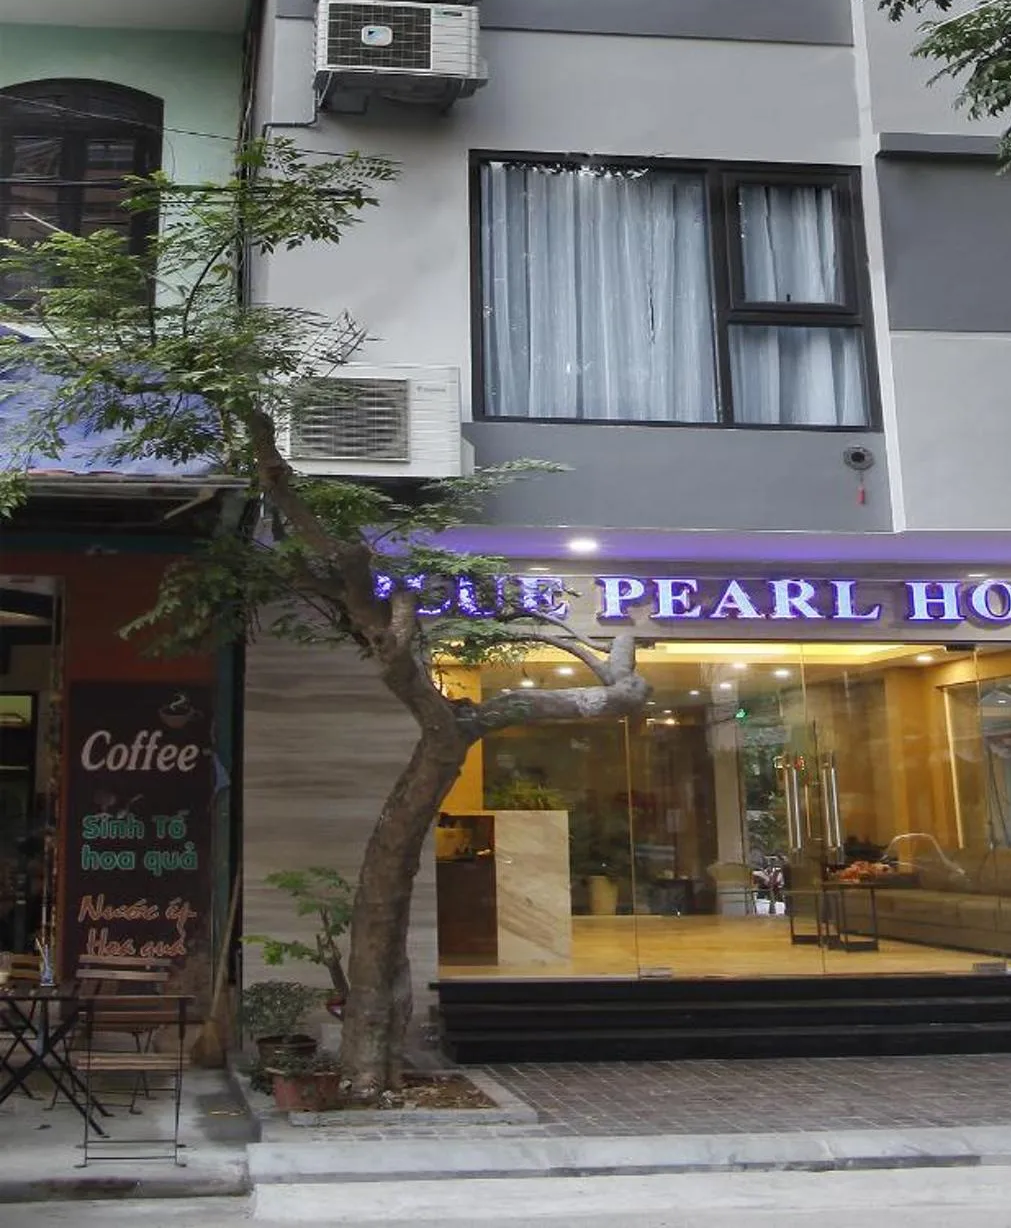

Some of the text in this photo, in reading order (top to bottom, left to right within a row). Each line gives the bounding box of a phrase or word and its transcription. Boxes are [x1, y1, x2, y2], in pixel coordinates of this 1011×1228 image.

[596, 576, 881, 620] PEARL
[81, 730, 200, 771] Coffee
[82, 814, 145, 839] Sinh
[81, 841, 198, 876] hoa quả
